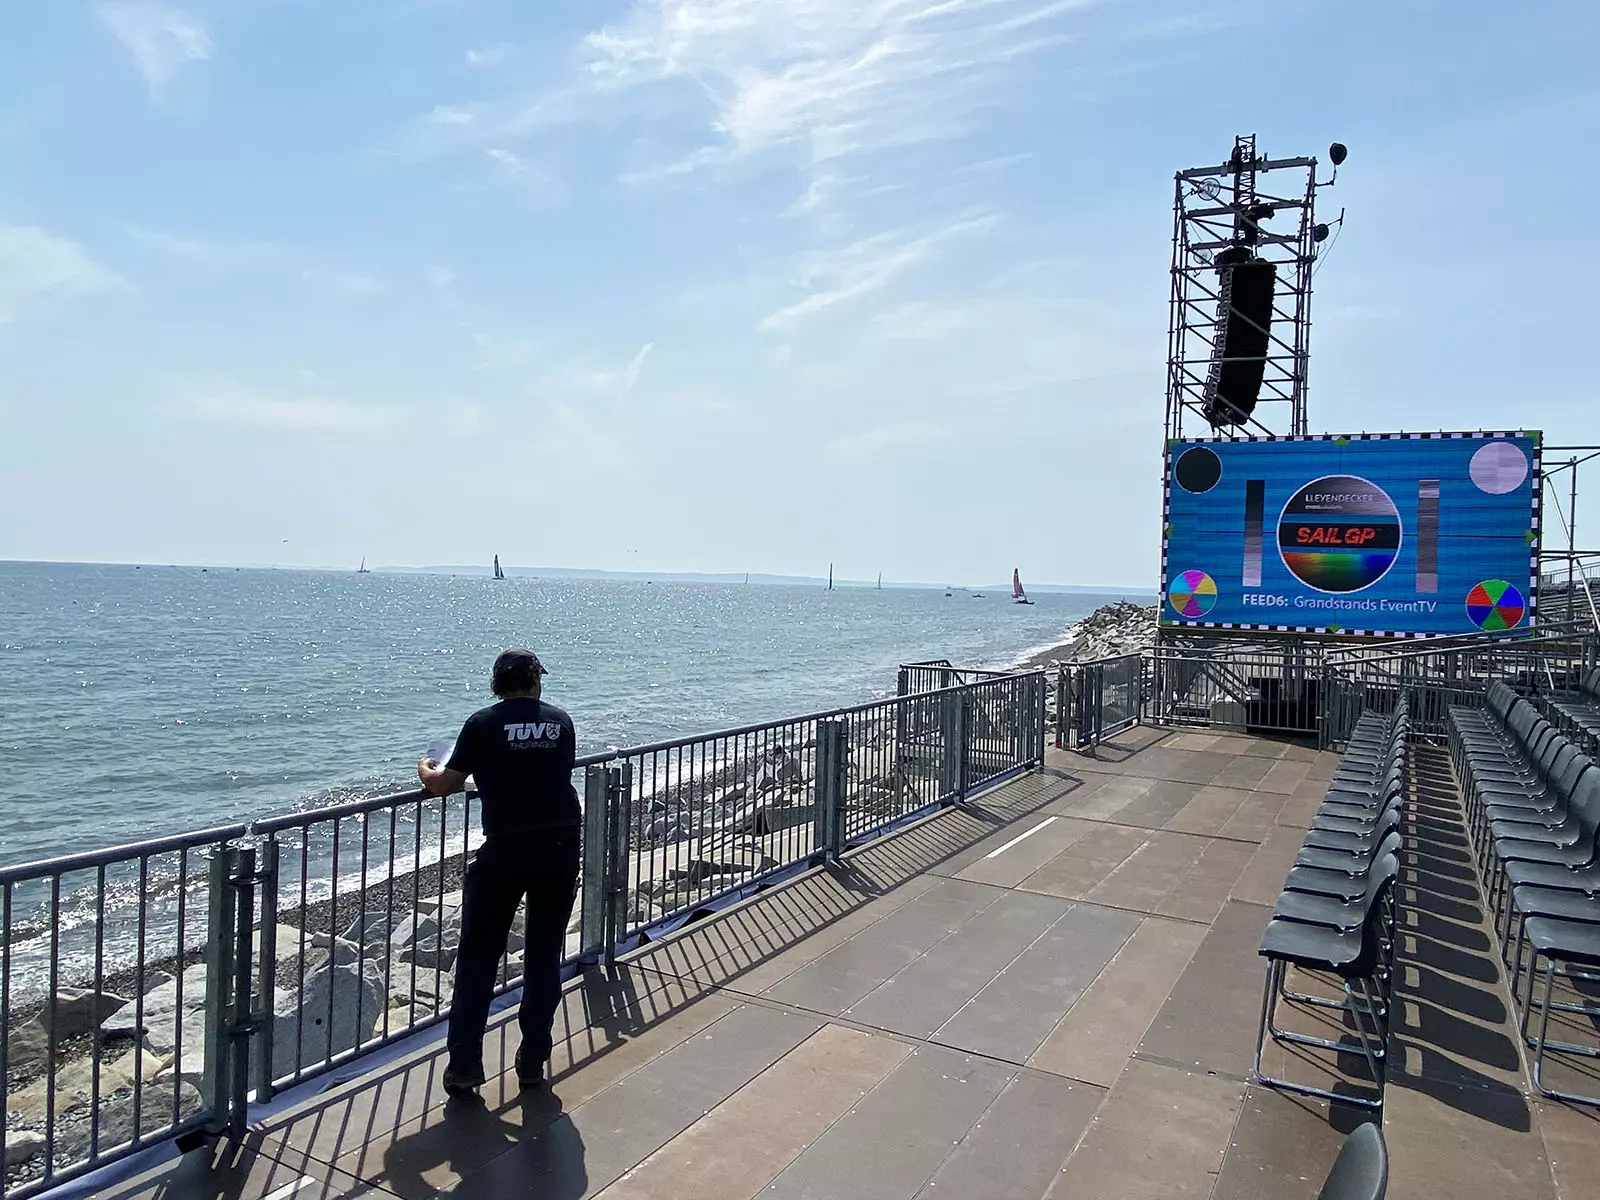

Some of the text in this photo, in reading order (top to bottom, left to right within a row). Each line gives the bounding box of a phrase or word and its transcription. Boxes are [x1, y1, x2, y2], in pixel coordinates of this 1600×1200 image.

[1242, 593, 1437, 613] FEED6: Grandstands EventTV
